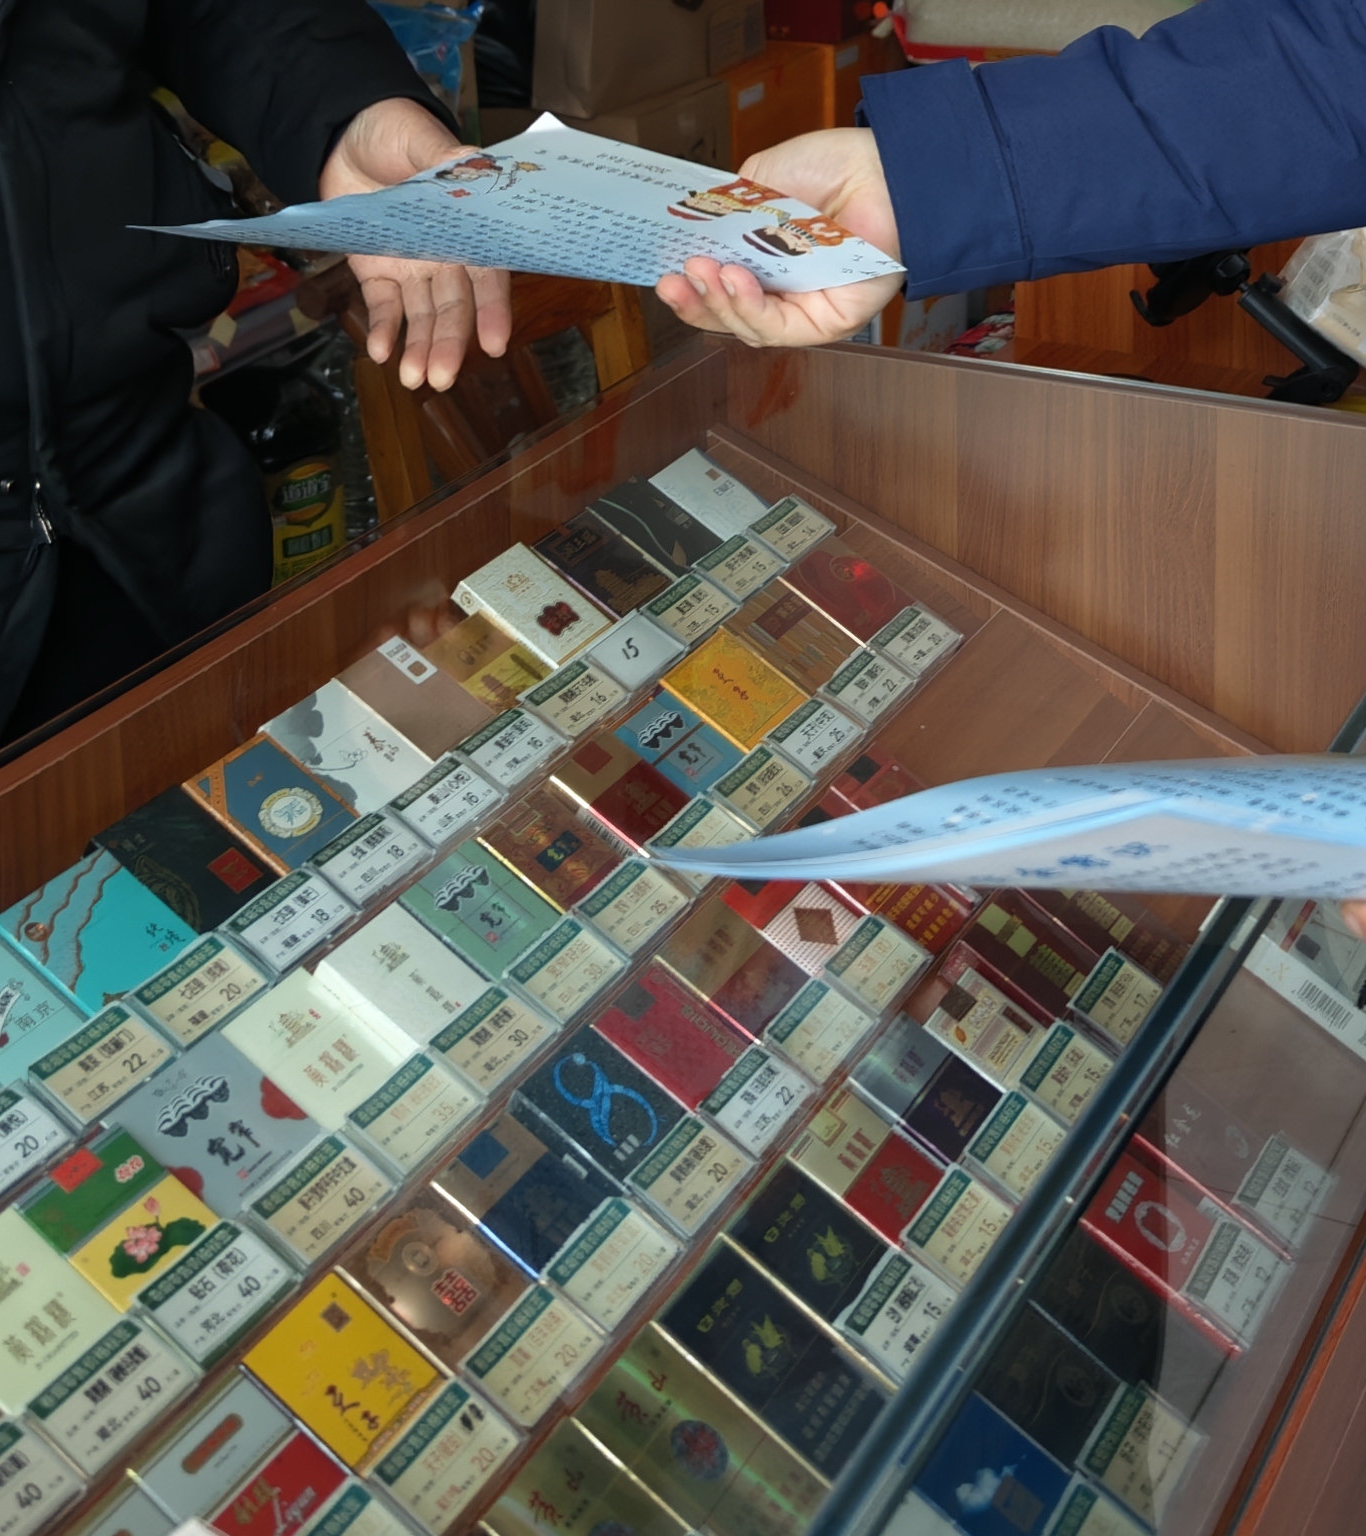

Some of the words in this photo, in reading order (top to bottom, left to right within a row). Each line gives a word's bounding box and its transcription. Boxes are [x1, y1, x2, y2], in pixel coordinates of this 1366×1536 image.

[750, 559, 768, 576] 15
[703, 602, 720, 619] 15
[616, 635, 644, 663] 15
[588, 689, 608, 708] 16
[525, 734, 544, 753] 16
[460, 789, 480, 809] 16
[386, 843, 405, 861] 18
[311, 907, 332, 927] 18
[217, 980, 243, 1003] 20
[1131, 992, 1150, 1011] 17
[13, 998, 55, 1034] 南京
[506, 1025, 530, 1049] 30
[120, 1049, 148, 1075] 22
[1081, 1065, 1102, 1086] 15
[773, 1083, 797, 1107] 22
[14, 1134, 40, 1161] 20
[1034, 1136, 1055, 1157] 15
[707, 1161, 729, 1183] 20
[340, 1183, 368, 1211] 40
[308, 1218, 334, 1242] 四川
[976, 1216, 999, 1240] 15
[233, 1271, 263, 1301] 40
[133, 1373, 164, 1403] 40
[15, 1479, 44, 1509] 40
